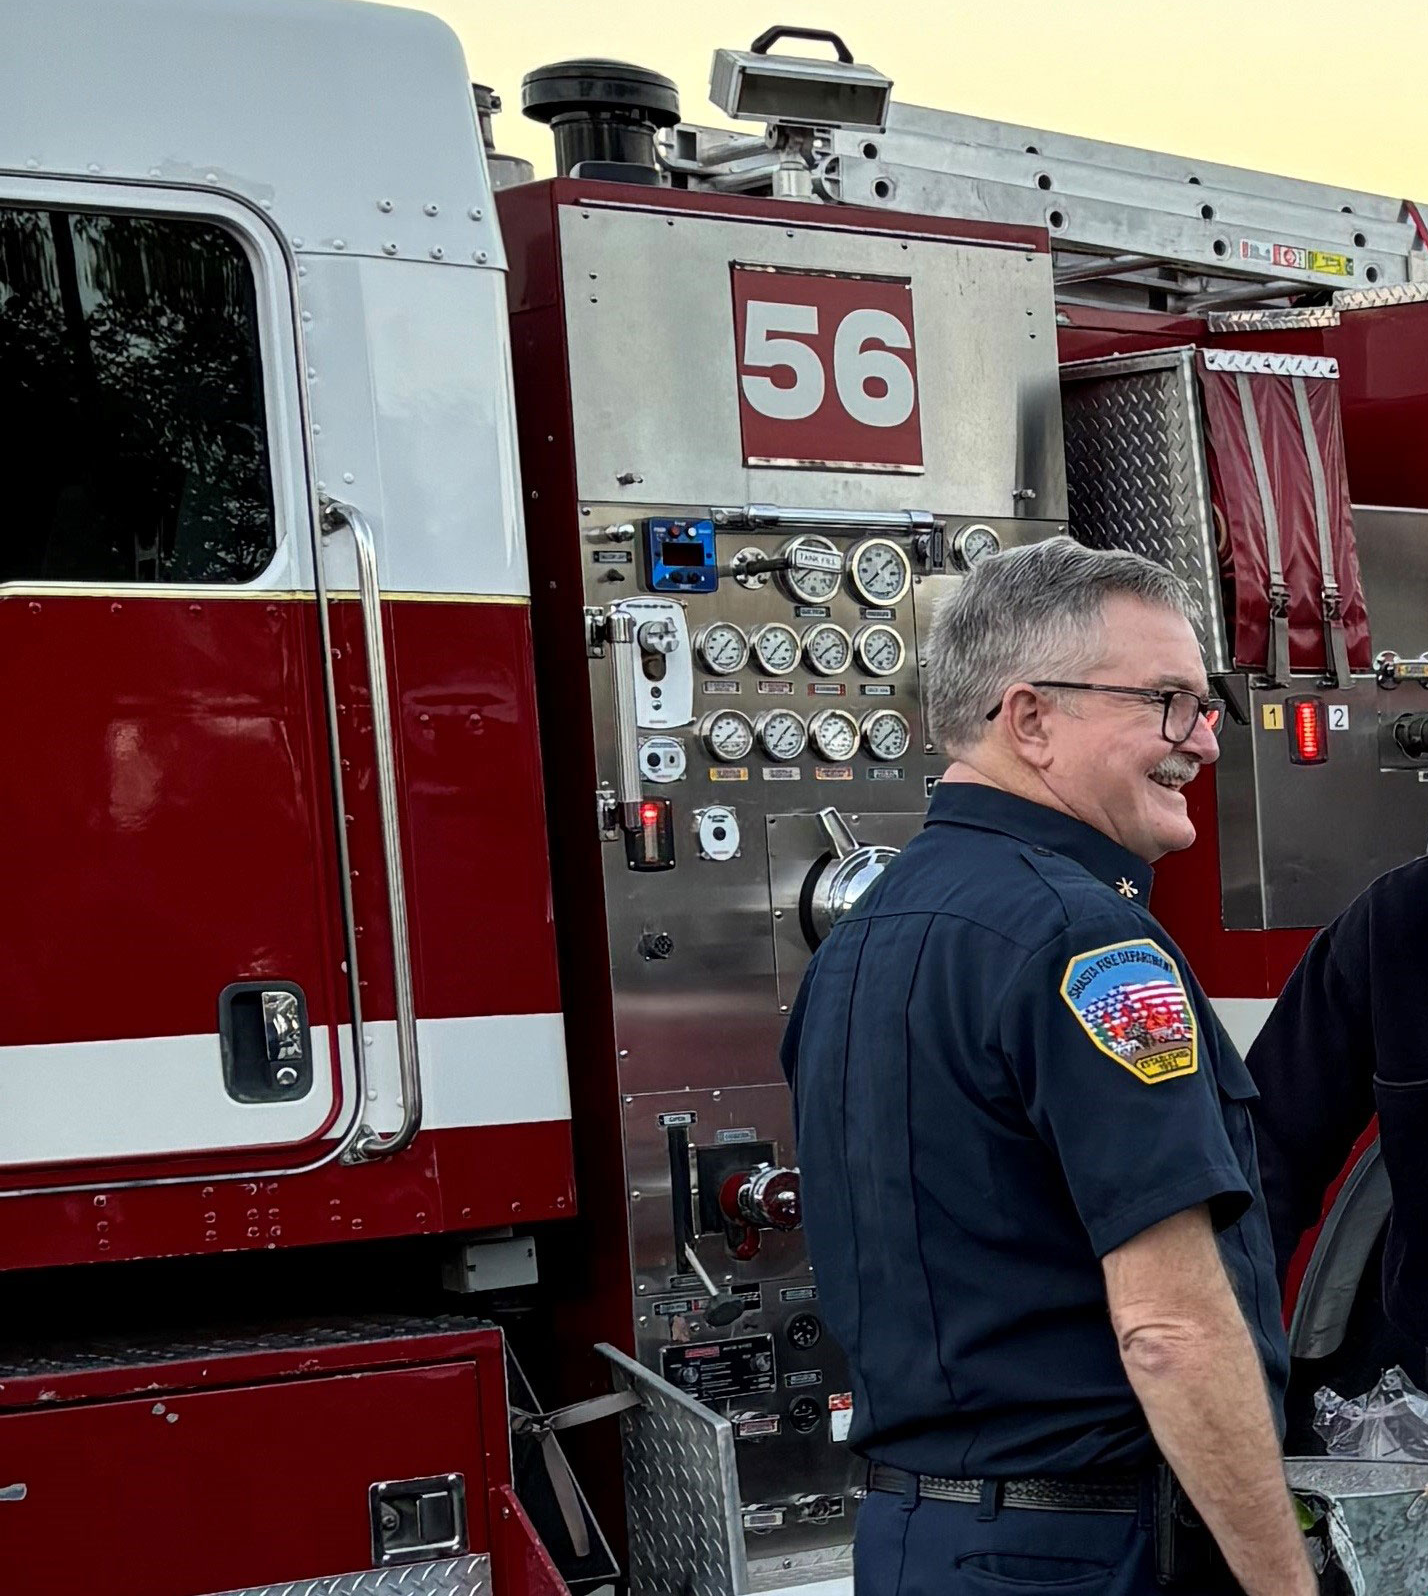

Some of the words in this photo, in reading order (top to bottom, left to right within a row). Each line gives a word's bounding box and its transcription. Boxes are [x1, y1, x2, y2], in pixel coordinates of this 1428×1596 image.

[742, 300, 916, 428] 56
[800, 553, 819, 565] TANK
[821, 556, 837, 567] FILL
[1269, 707, 1278, 727] 1
[1332, 708, 1345, 728] 2
[1067, 966, 1099, 1000] SHASTA
[1096, 952, 1119, 973] FIRE
